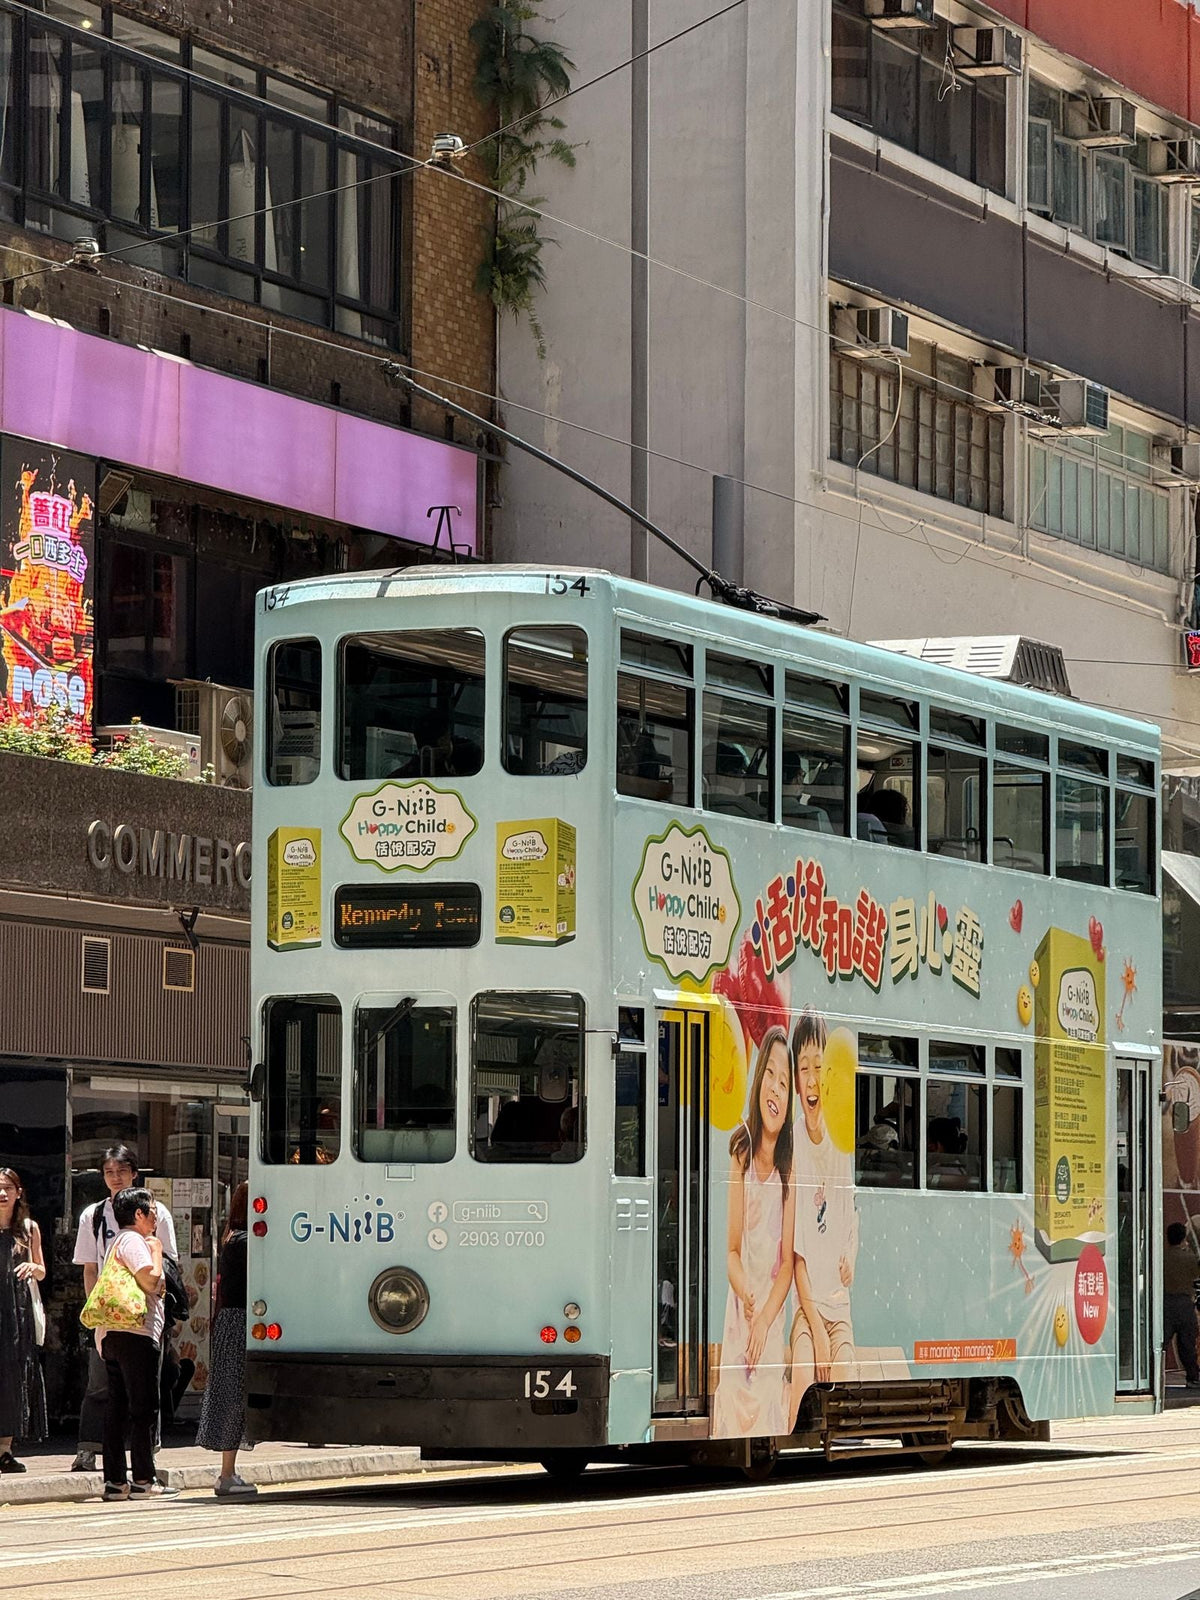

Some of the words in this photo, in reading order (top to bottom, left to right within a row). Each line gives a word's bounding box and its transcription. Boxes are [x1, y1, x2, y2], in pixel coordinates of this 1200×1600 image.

[16, 534, 85, 577] 一口西多士
[545, 574, 591, 598] 154
[264, 586, 290, 611] 154
[405, 818, 447, 834] Child
[375, 839, 437, 858] 恬悅配方
[687, 893, 720, 921] Child
[663, 925, 712, 959] 恬悅配方
[461, 1203, 502, 1221] g-niib
[459, 1231, 500, 1247] 2903
[504, 1231, 545, 1247] 0700
[1083, 1300, 1100, 1319] New
[929, 1343, 961, 1361] mannings
[964, 1342, 994, 1360] mannings
[524, 1369, 578, 1398] 154
